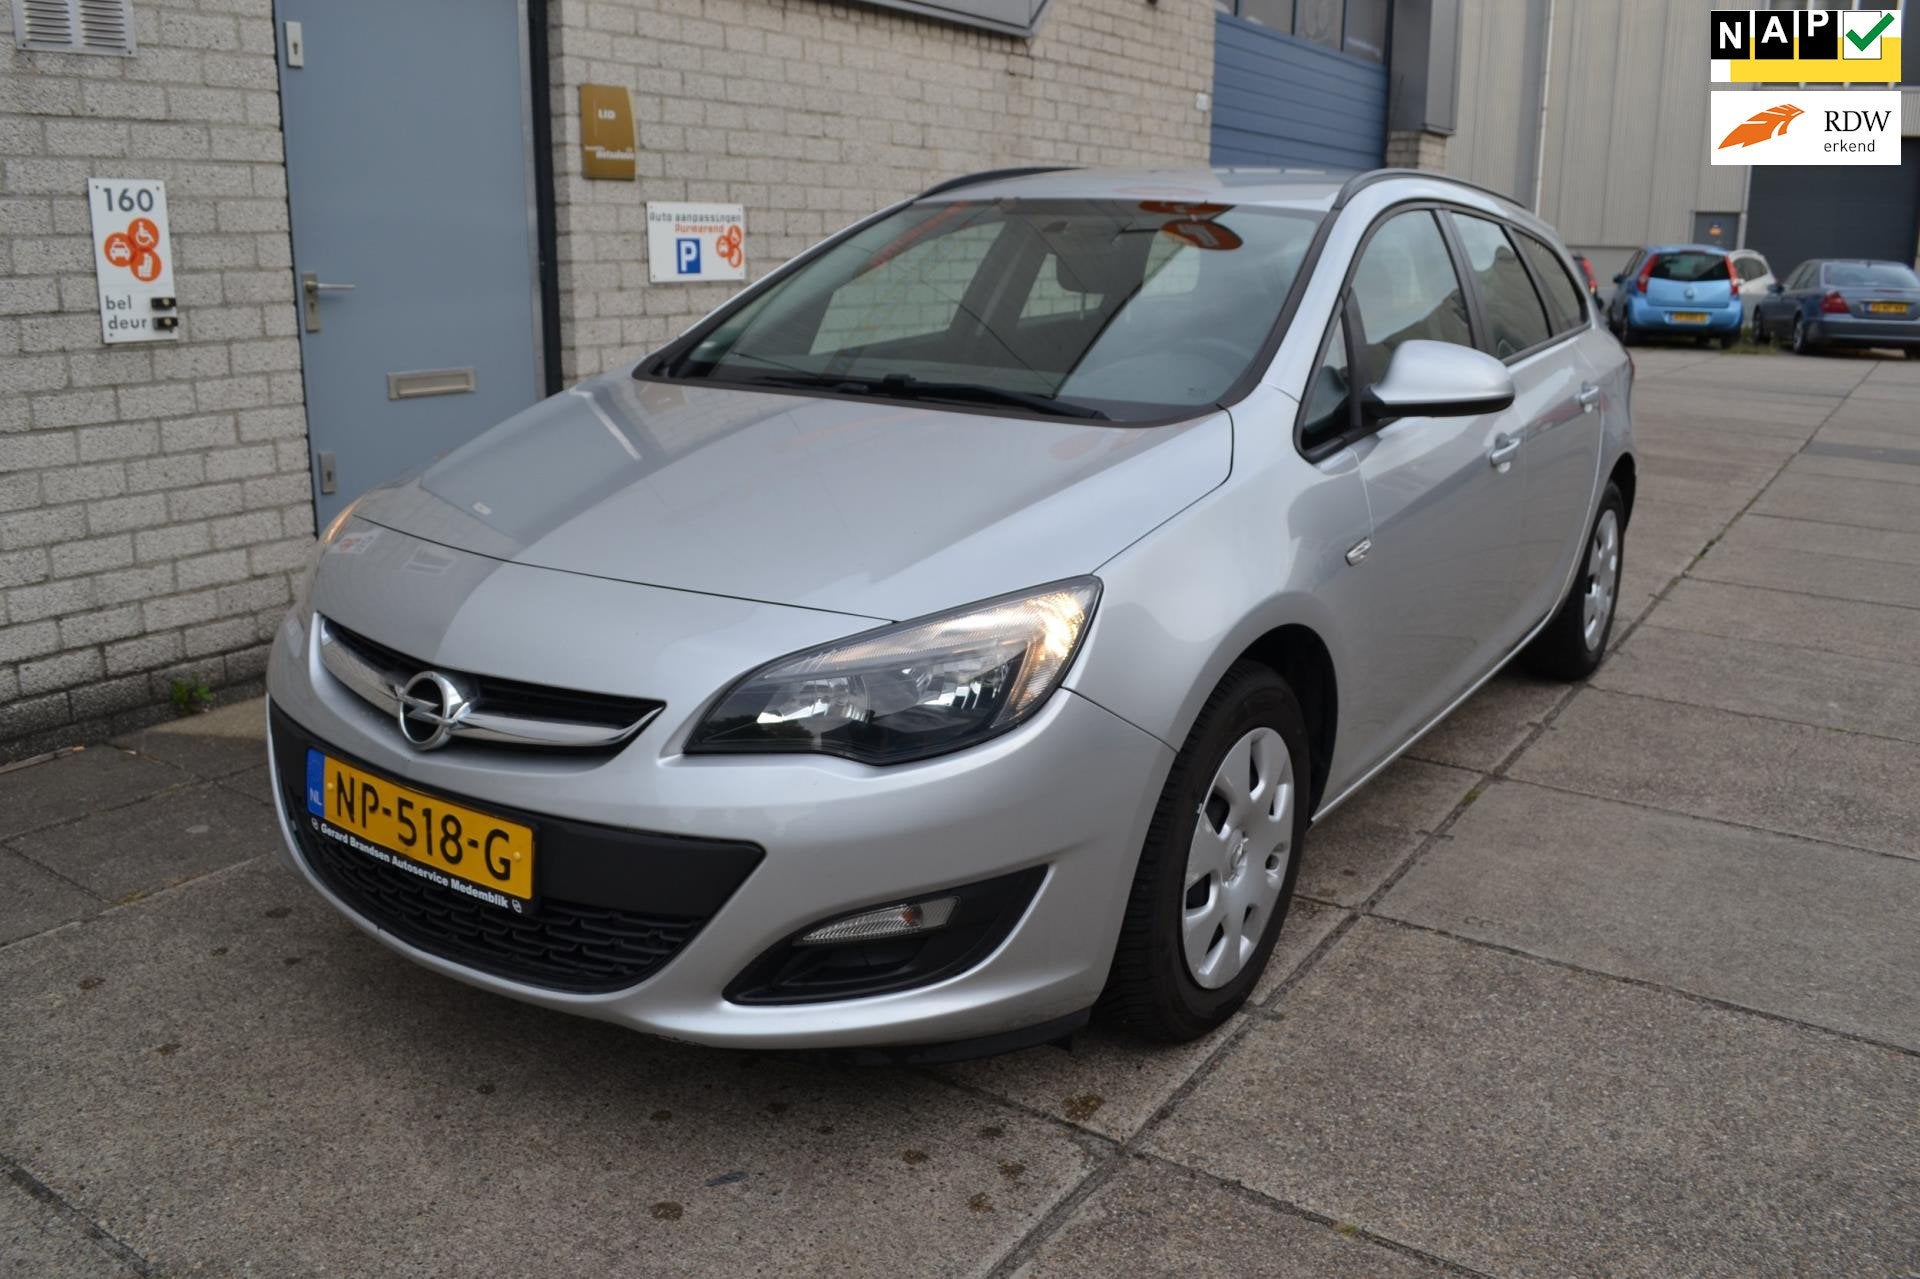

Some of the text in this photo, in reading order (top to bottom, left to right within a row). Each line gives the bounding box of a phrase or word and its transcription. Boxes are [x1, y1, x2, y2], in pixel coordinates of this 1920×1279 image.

[103, 187, 154, 212] 160
[650, 212, 741, 223] Auto aanpassingen
[680, 240, 698, 272] P
[106, 295, 131, 310] bel
[108, 315, 147, 330] deur
[309, 787, 322, 806] NL
[336, 770, 512, 882] NP-518-G
[320, 822, 509, 909] Gerard Brandsen Autoservice Medemblik
